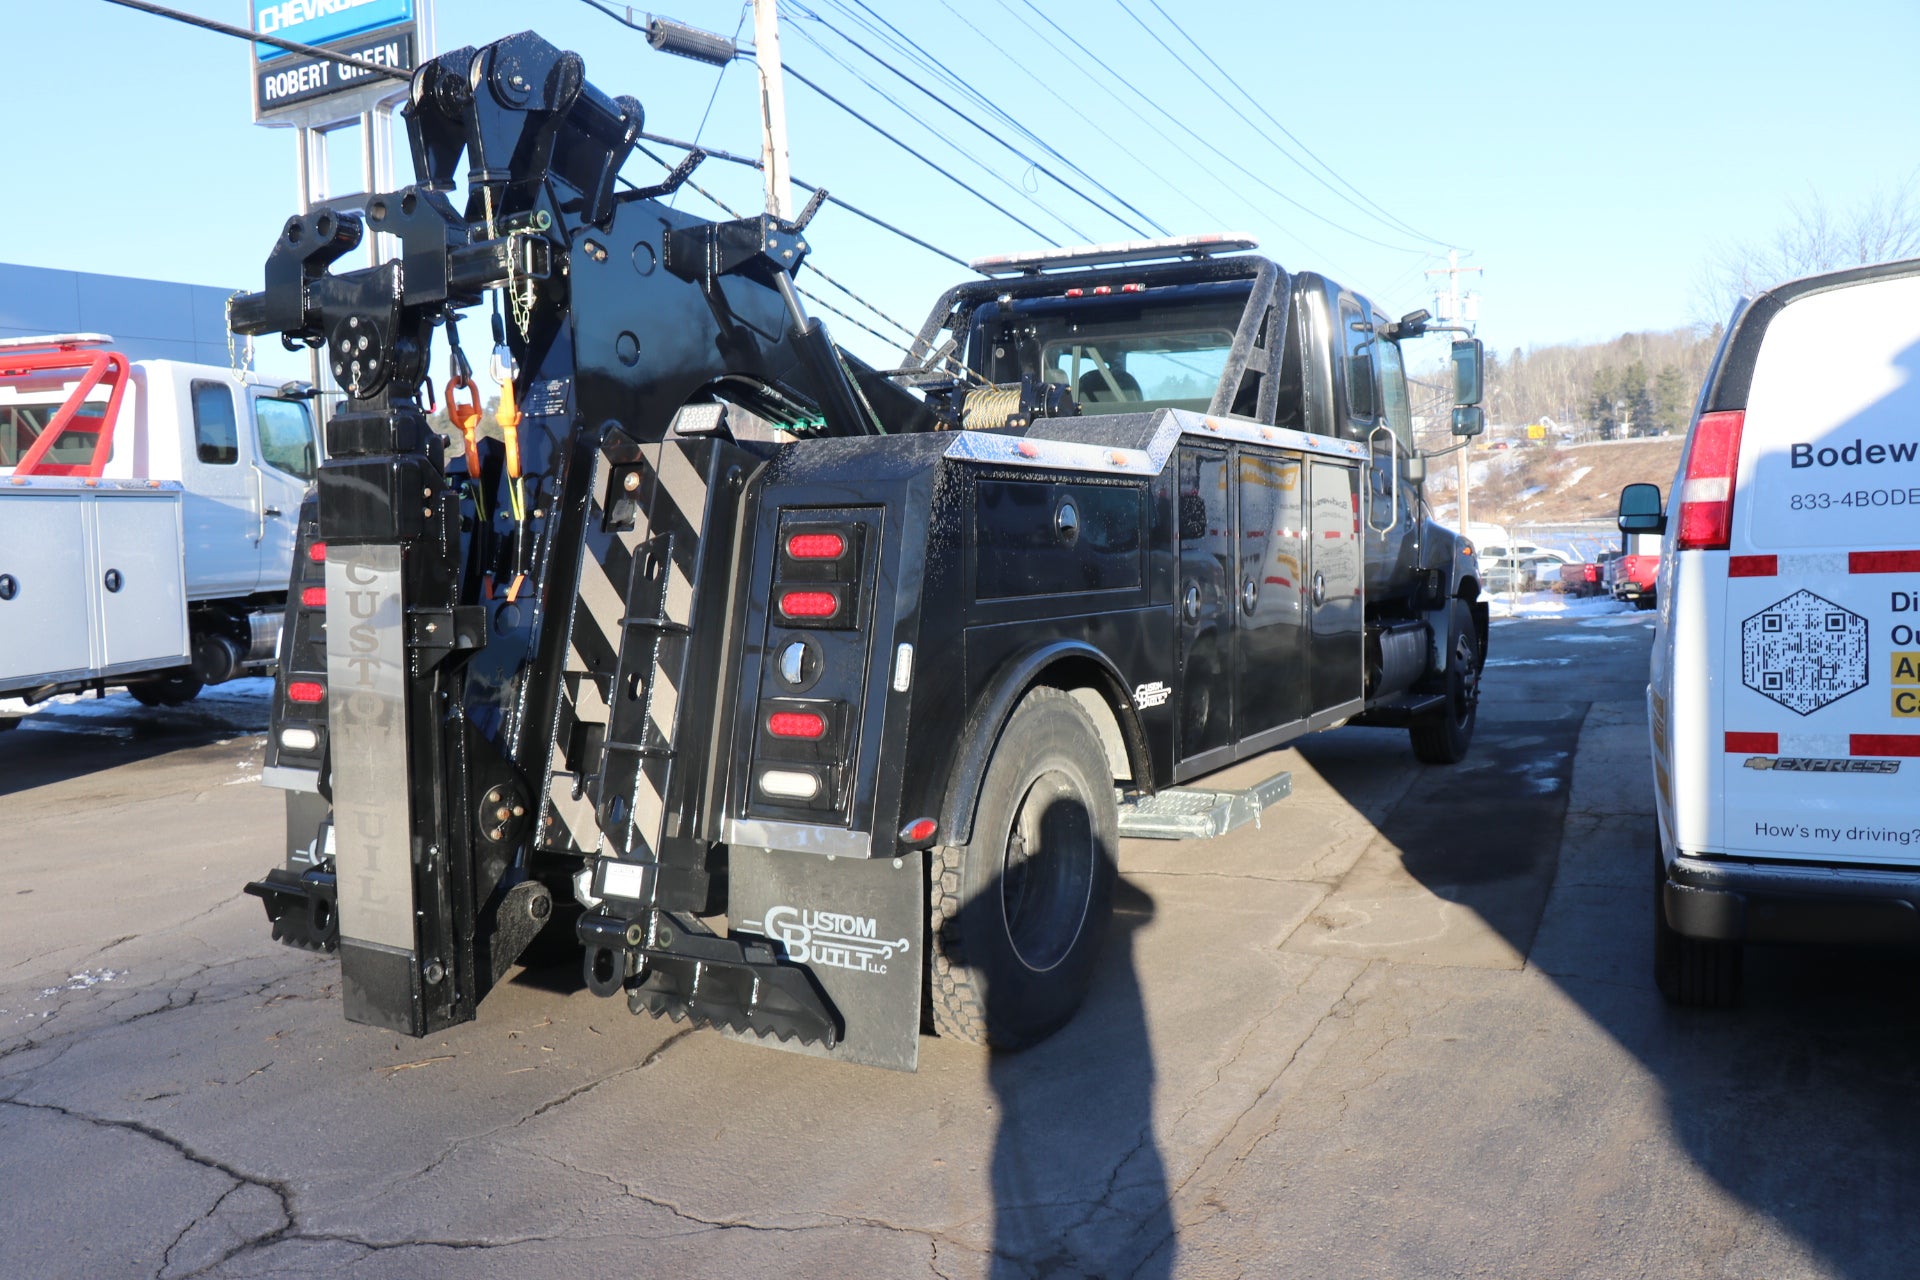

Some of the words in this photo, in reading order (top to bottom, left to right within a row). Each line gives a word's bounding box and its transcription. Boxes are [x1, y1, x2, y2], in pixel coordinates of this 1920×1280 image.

[265, 61, 330, 100] ROBERT
[1791, 438, 1919, 468] Bodew
[345, 555, 389, 750] CUSTOM
[1895, 657, 1920, 682] A
[1895, 692, 1920, 713] C
[1774, 758, 1901, 773] EXPRESS
[1755, 822, 1809, 838] How's
[1815, 827, 1841, 842] my
[1846, 827, 1920, 845] driving?
[868, 964, 887, 974] LLC
